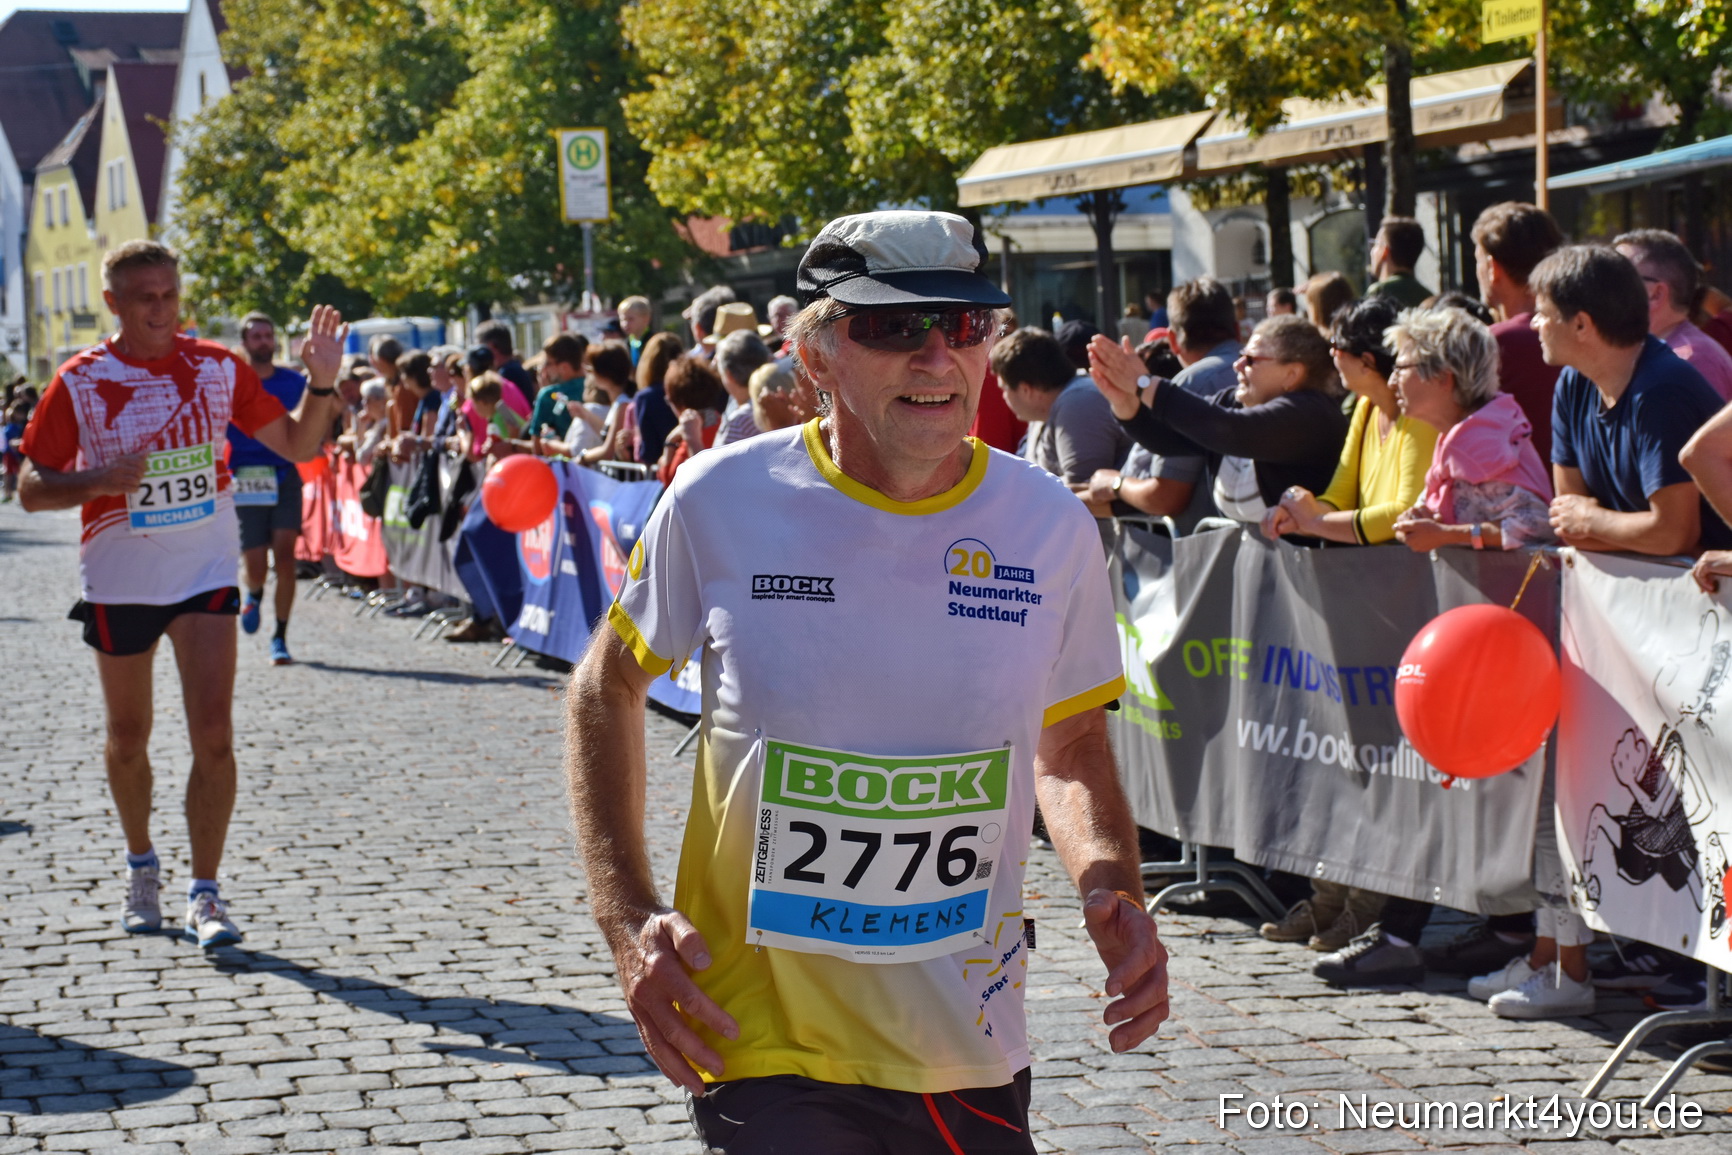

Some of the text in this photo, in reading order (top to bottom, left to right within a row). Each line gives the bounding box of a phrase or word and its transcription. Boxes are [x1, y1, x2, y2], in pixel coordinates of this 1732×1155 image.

[146, 451, 208, 473] OCK
[139, 474, 208, 506] 2139
[144, 506, 206, 525] MICHAEL
[950, 548, 1032, 581] 20 JAHRE
[752, 574, 835, 596] BOCK
[777, 593, 785, 601] by
[806, 595, 835, 603] concepts
[948, 580, 1042, 606] Neumarkter
[947, 601, 1029, 627] Stadtlauf
[780, 752, 993, 811] BOCK
[783, 820, 979, 893] 2776
[810, 901, 968, 935] KLEMENS
